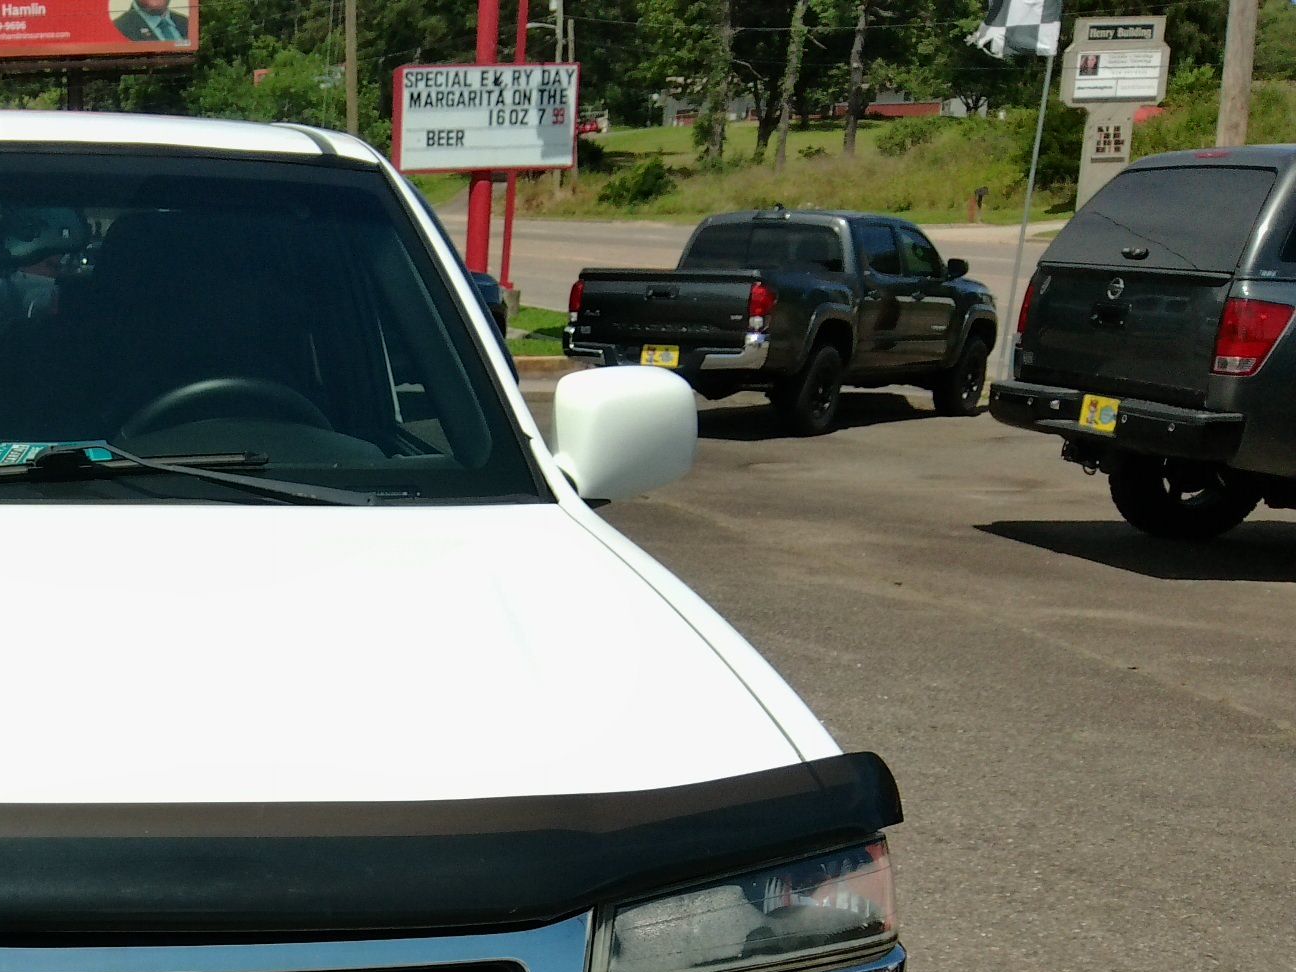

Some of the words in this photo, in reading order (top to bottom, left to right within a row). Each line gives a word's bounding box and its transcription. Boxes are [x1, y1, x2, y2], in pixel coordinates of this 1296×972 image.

[3, 3, 46, 16] Hamlin
[1089, 28, 1115, 39] Henry
[1117, 27, 1152, 39] Building
[405, 71, 472, 88] SPECIAL
[541, 69, 575, 86] DAY
[409, 90, 505, 108] MARGARITA
[513, 89, 532, 106] ON
[538, 88, 568, 106] THE
[538, 108, 546, 124] 7
[426, 130, 465, 147] BEER
